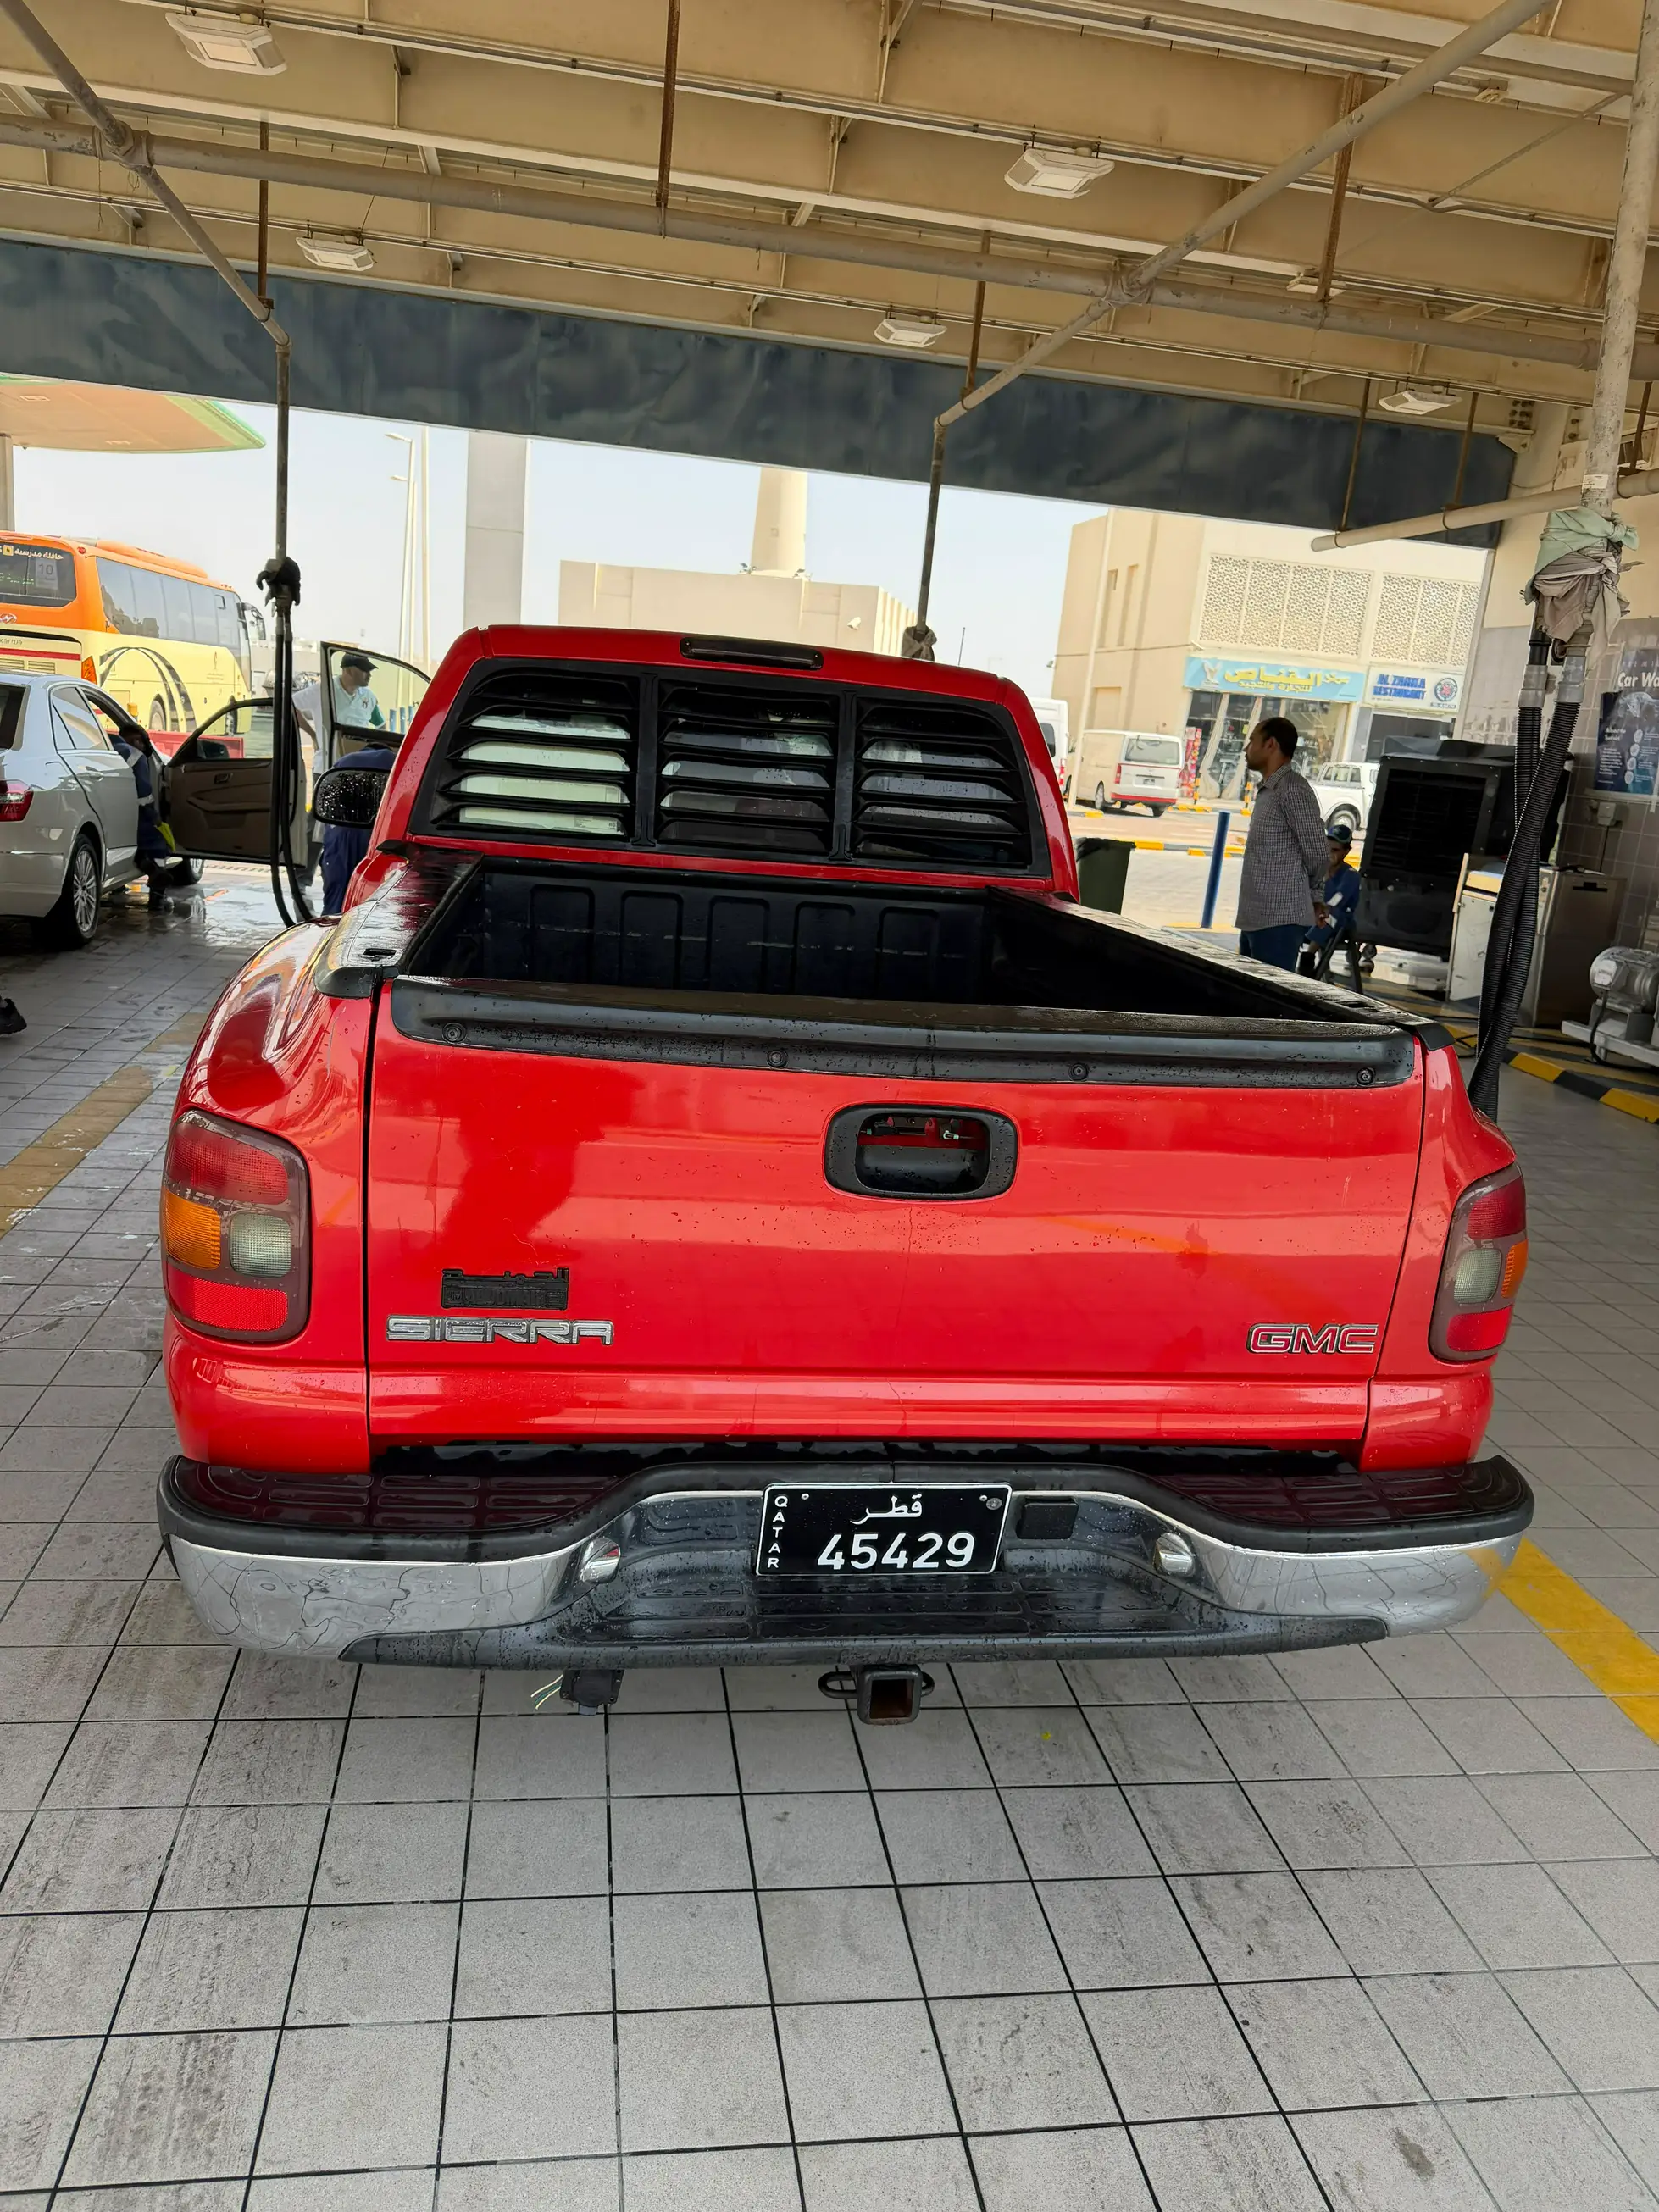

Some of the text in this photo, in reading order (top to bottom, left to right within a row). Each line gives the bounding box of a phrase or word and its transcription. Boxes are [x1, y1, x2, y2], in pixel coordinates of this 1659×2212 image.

[39, 563, 53, 575] 10
[1224, 666, 1323, 687] القناص
[1617, 671, 1639, 688] Car
[386, 1315, 613, 1345] SIERRA
[1246, 1323, 1379, 1355] GMC
[849, 1493, 924, 1525] قطر
[767, 1494, 789, 1569] QATAR
[817, 1532, 976, 1570] 45429
